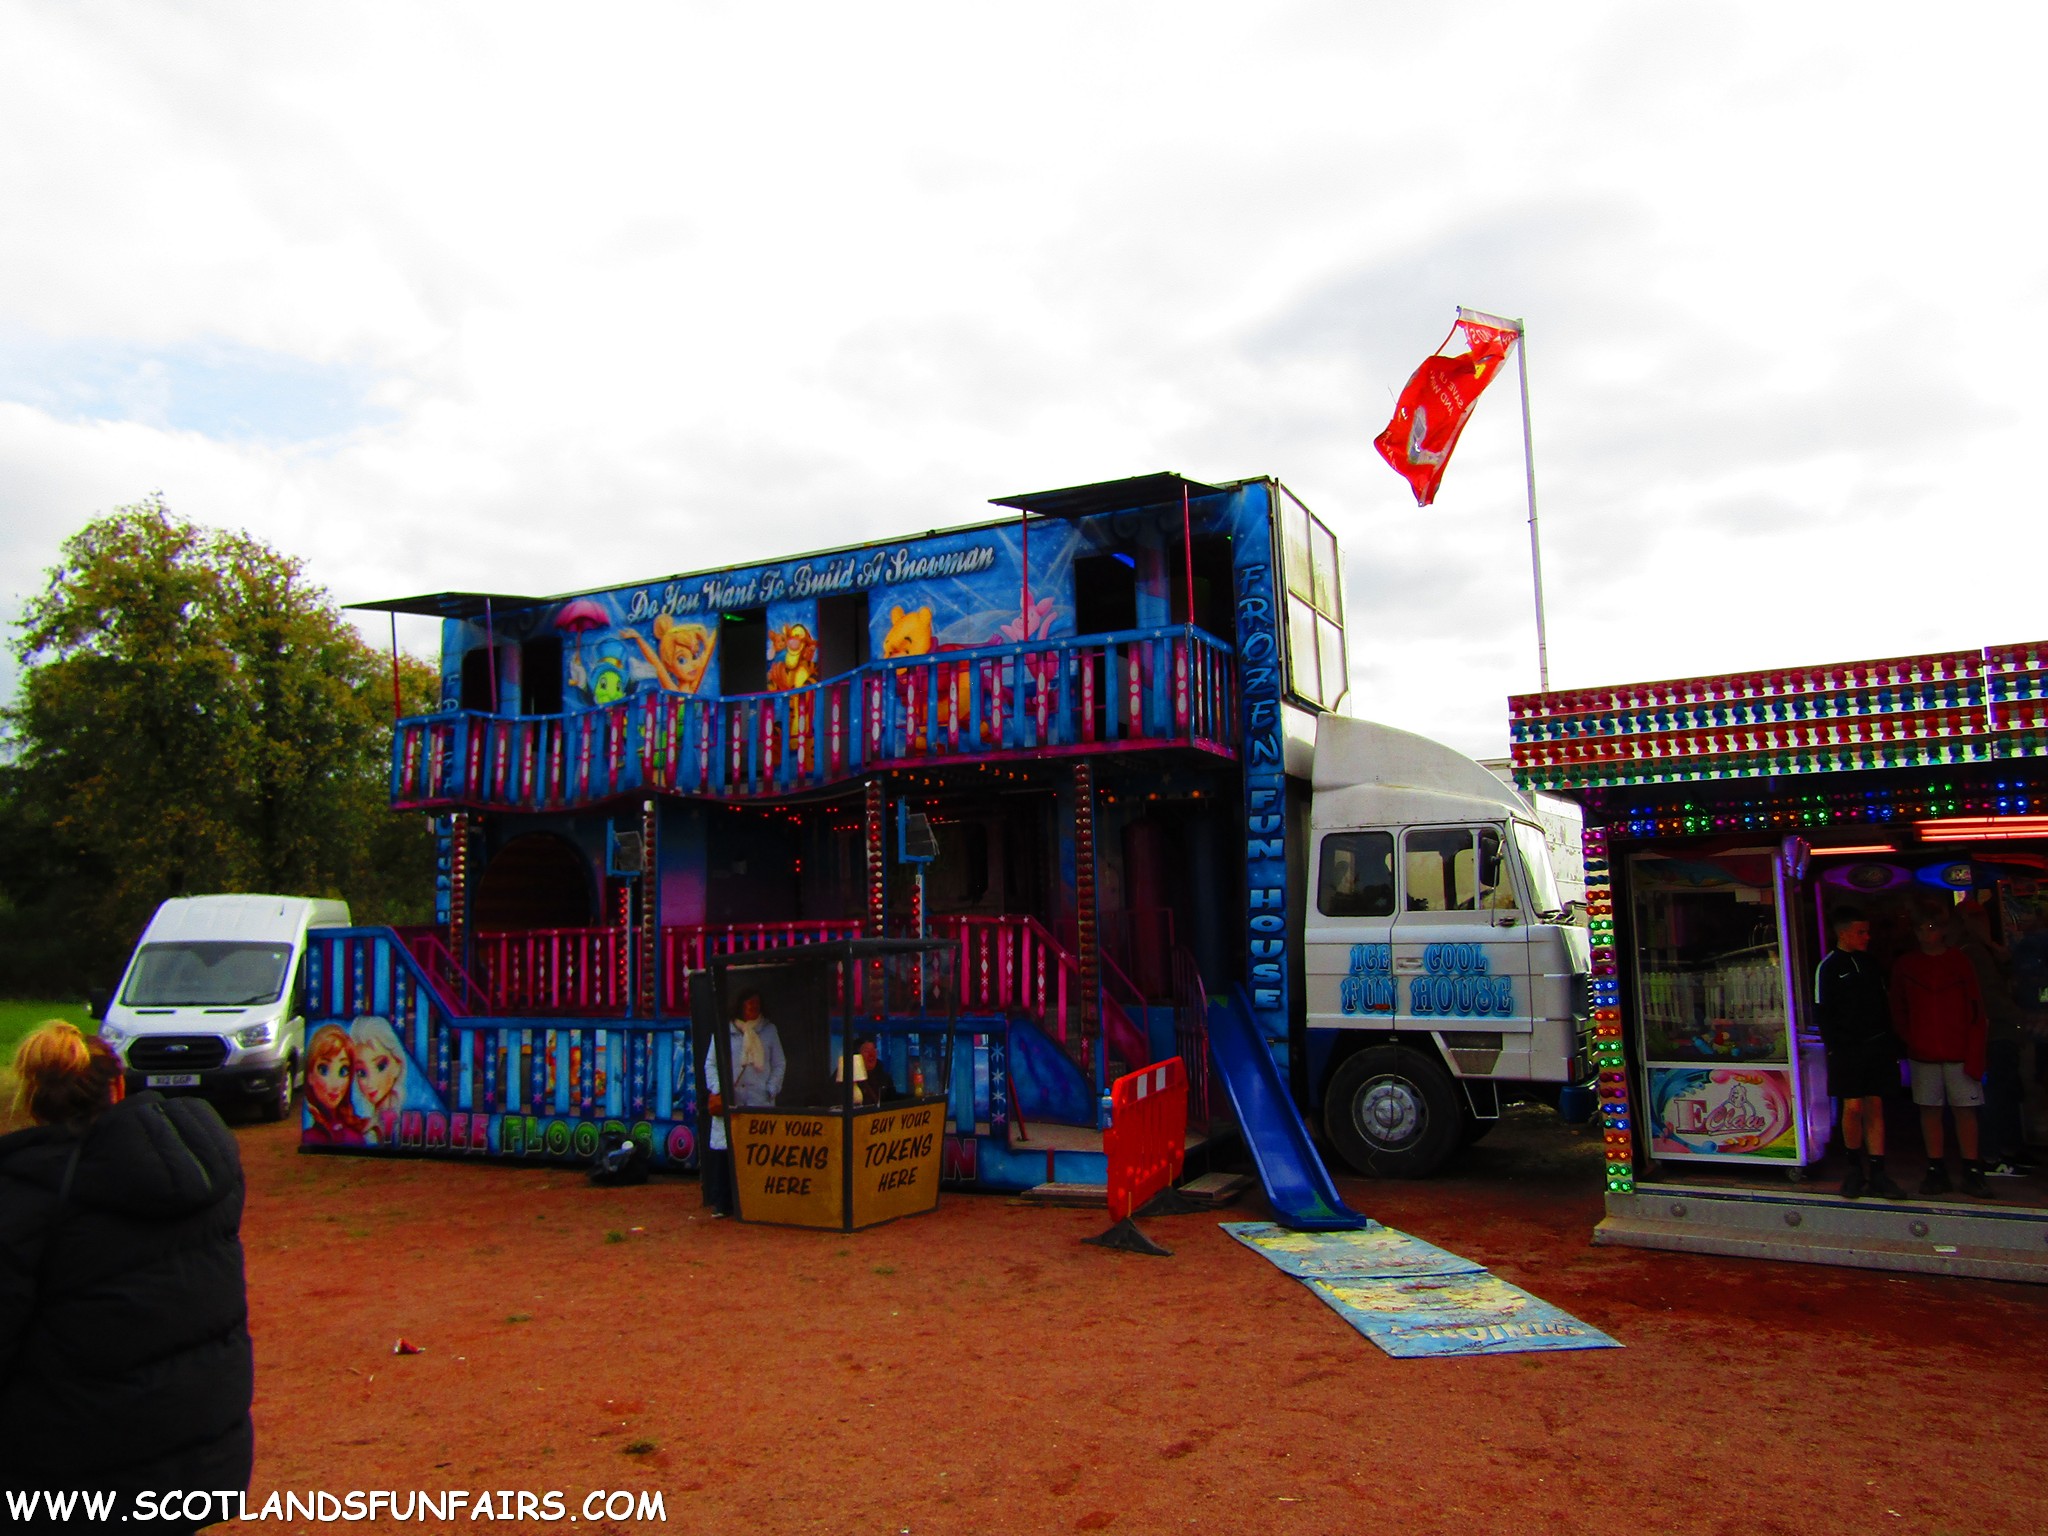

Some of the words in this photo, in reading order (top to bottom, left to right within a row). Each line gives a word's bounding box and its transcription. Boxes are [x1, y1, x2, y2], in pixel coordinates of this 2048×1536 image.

[628, 590, 658, 622] Do
[659, 584, 700, 616] You
[702, 579, 757, 610] Want
[760, 569, 786, 601] To
[788, 559, 856, 598] Build
[860, 551, 886, 584] A
[886, 546, 995, 581] Snowman
[1238, 564, 1279, 766] FROZEN
[1247, 790, 1284, 859] FUN
[1250, 889, 1285, 1009] HOUSE
[1352, 944, 1391, 972] ICE
[1426, 943, 1488, 972] COOL
[1344, 977, 1398, 1011] FUN
[1412, 976, 1512, 1013] HOUSE
[381, 1111, 490, 1151] THREE
[749, 1119, 776, 1136] BUY
[785, 1121, 823, 1137] YOUR
[870, 1116, 895, 1135] BUY
[901, 1110, 931, 1129] YOUR
[746, 1143, 828, 1170] TOKENS
[865, 1133, 933, 1168] TOKENS
[764, 1176, 812, 1195] HERE
[878, 1167, 919, 1192] HERE
